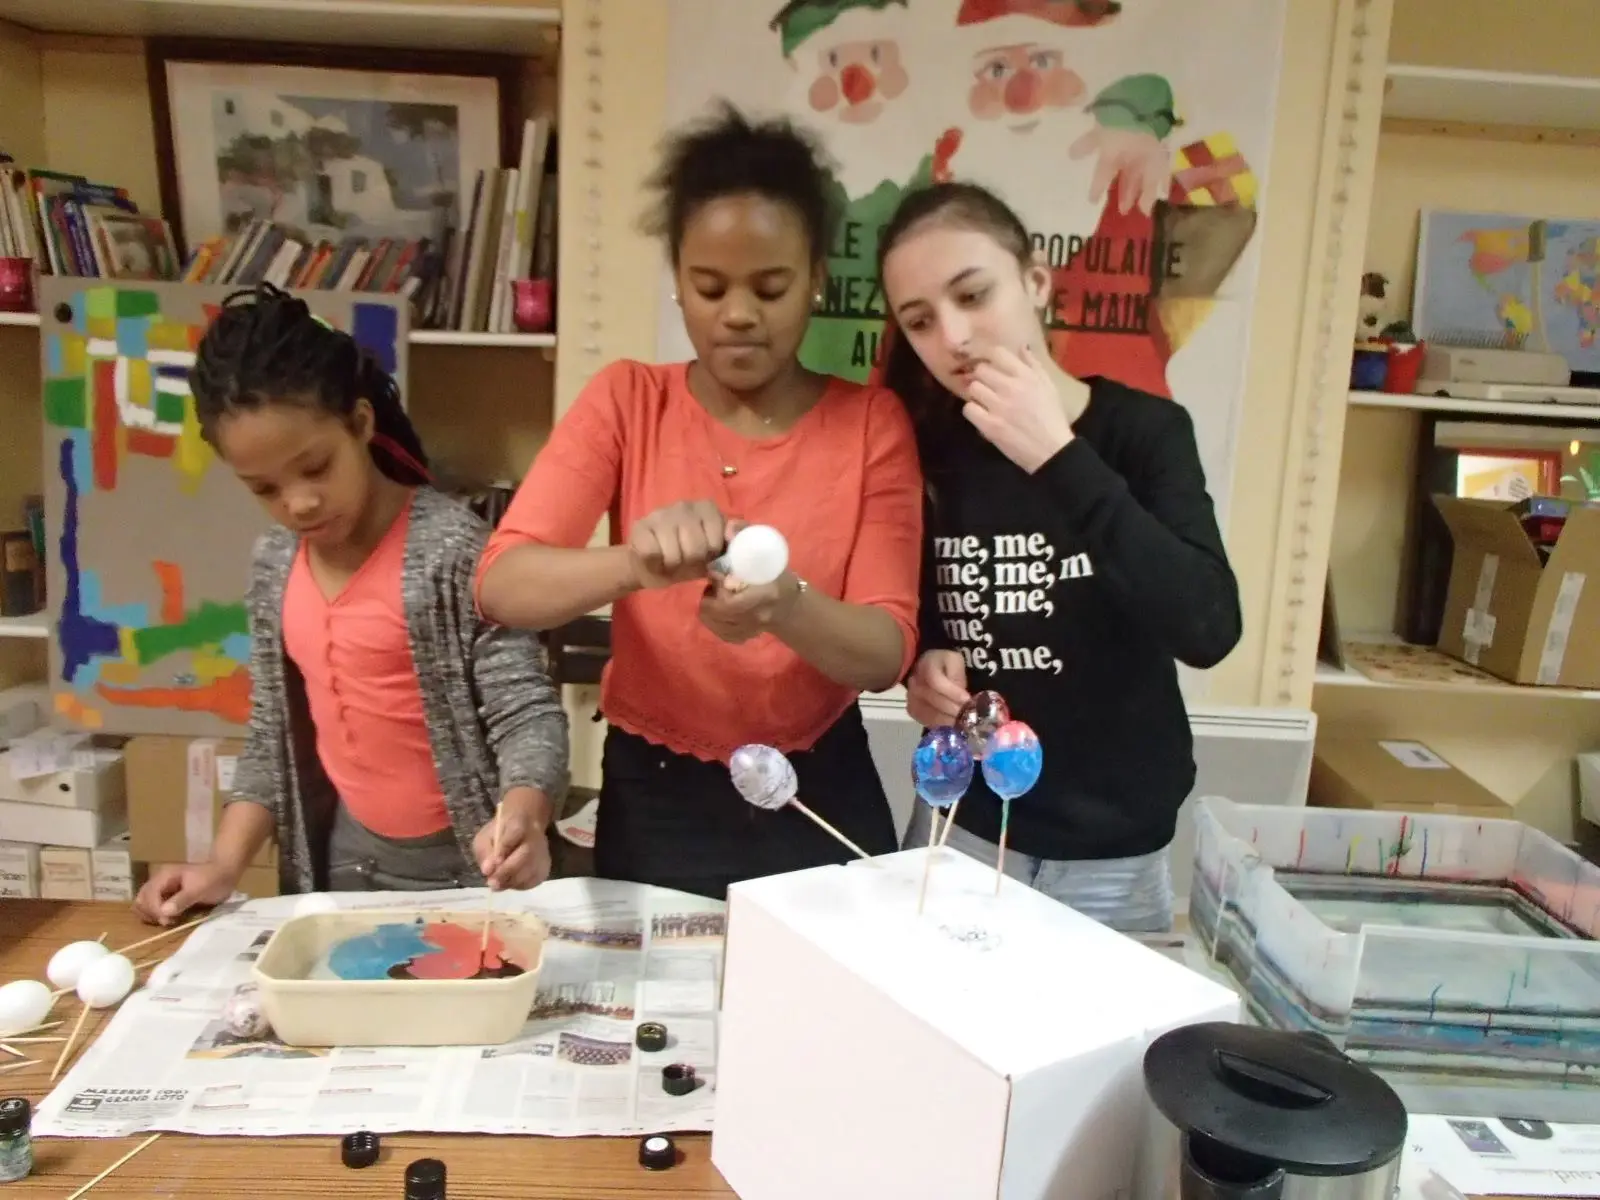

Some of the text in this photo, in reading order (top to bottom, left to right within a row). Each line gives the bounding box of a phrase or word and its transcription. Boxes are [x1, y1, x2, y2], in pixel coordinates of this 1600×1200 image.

[1031, 234, 1186, 278] POPULAIE
[1082, 291, 1149, 328] MAIN
[934, 532, 1055, 564] me, me,
[936, 552, 1094, 591] me, me, m
[937, 588, 1054, 620] me, me,
[943, 618, 994, 648] me,
[999, 645, 1064, 675] me,
